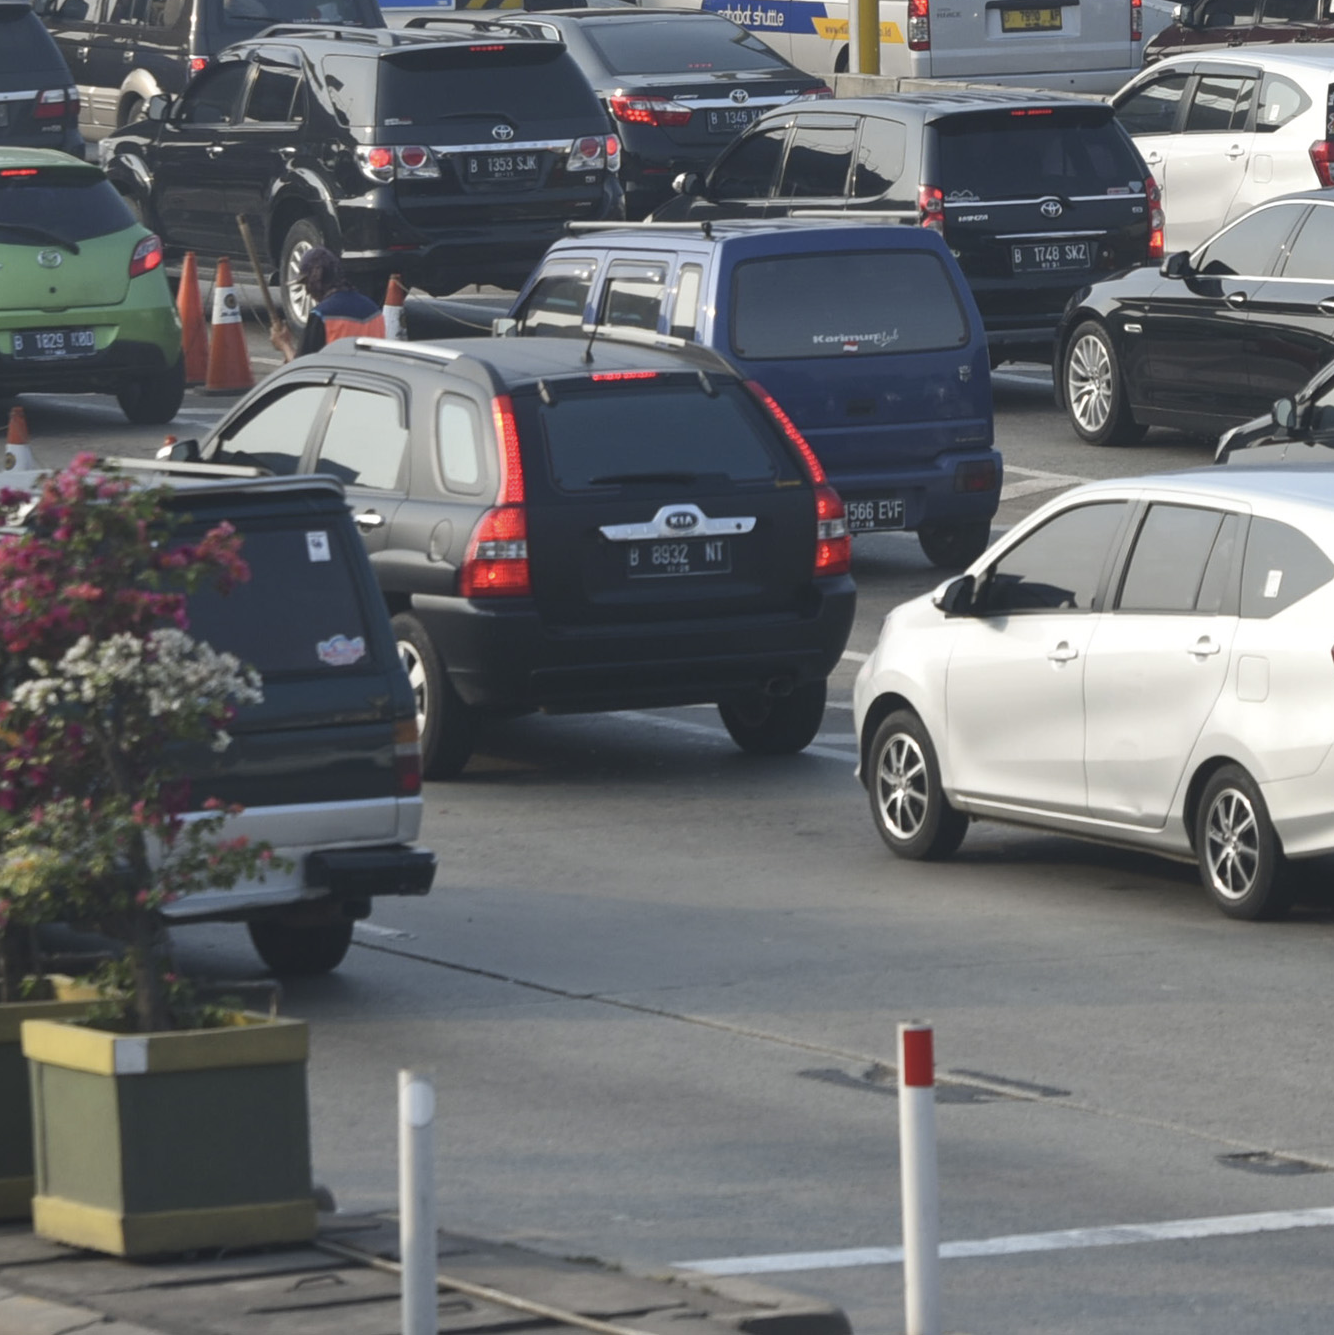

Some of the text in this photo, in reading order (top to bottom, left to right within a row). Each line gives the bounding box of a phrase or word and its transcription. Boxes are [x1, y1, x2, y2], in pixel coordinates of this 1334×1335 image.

[753, 5, 784, 27] shuttle
[711, 112, 718, 125] B
[470, 159, 478, 173] B
[487, 157, 513, 172] 1353
[1014, 244, 1086, 263] B 1748 SKZ
[14, 335, 23, 350] B
[35, 333, 65, 349] 1829
[813, 333, 877, 345] Karimun
[878, 500, 903, 519] EVF
[669, 515, 693, 526] KIA
[630, 546, 639, 567] B
[652, 544, 689, 564] 8932
